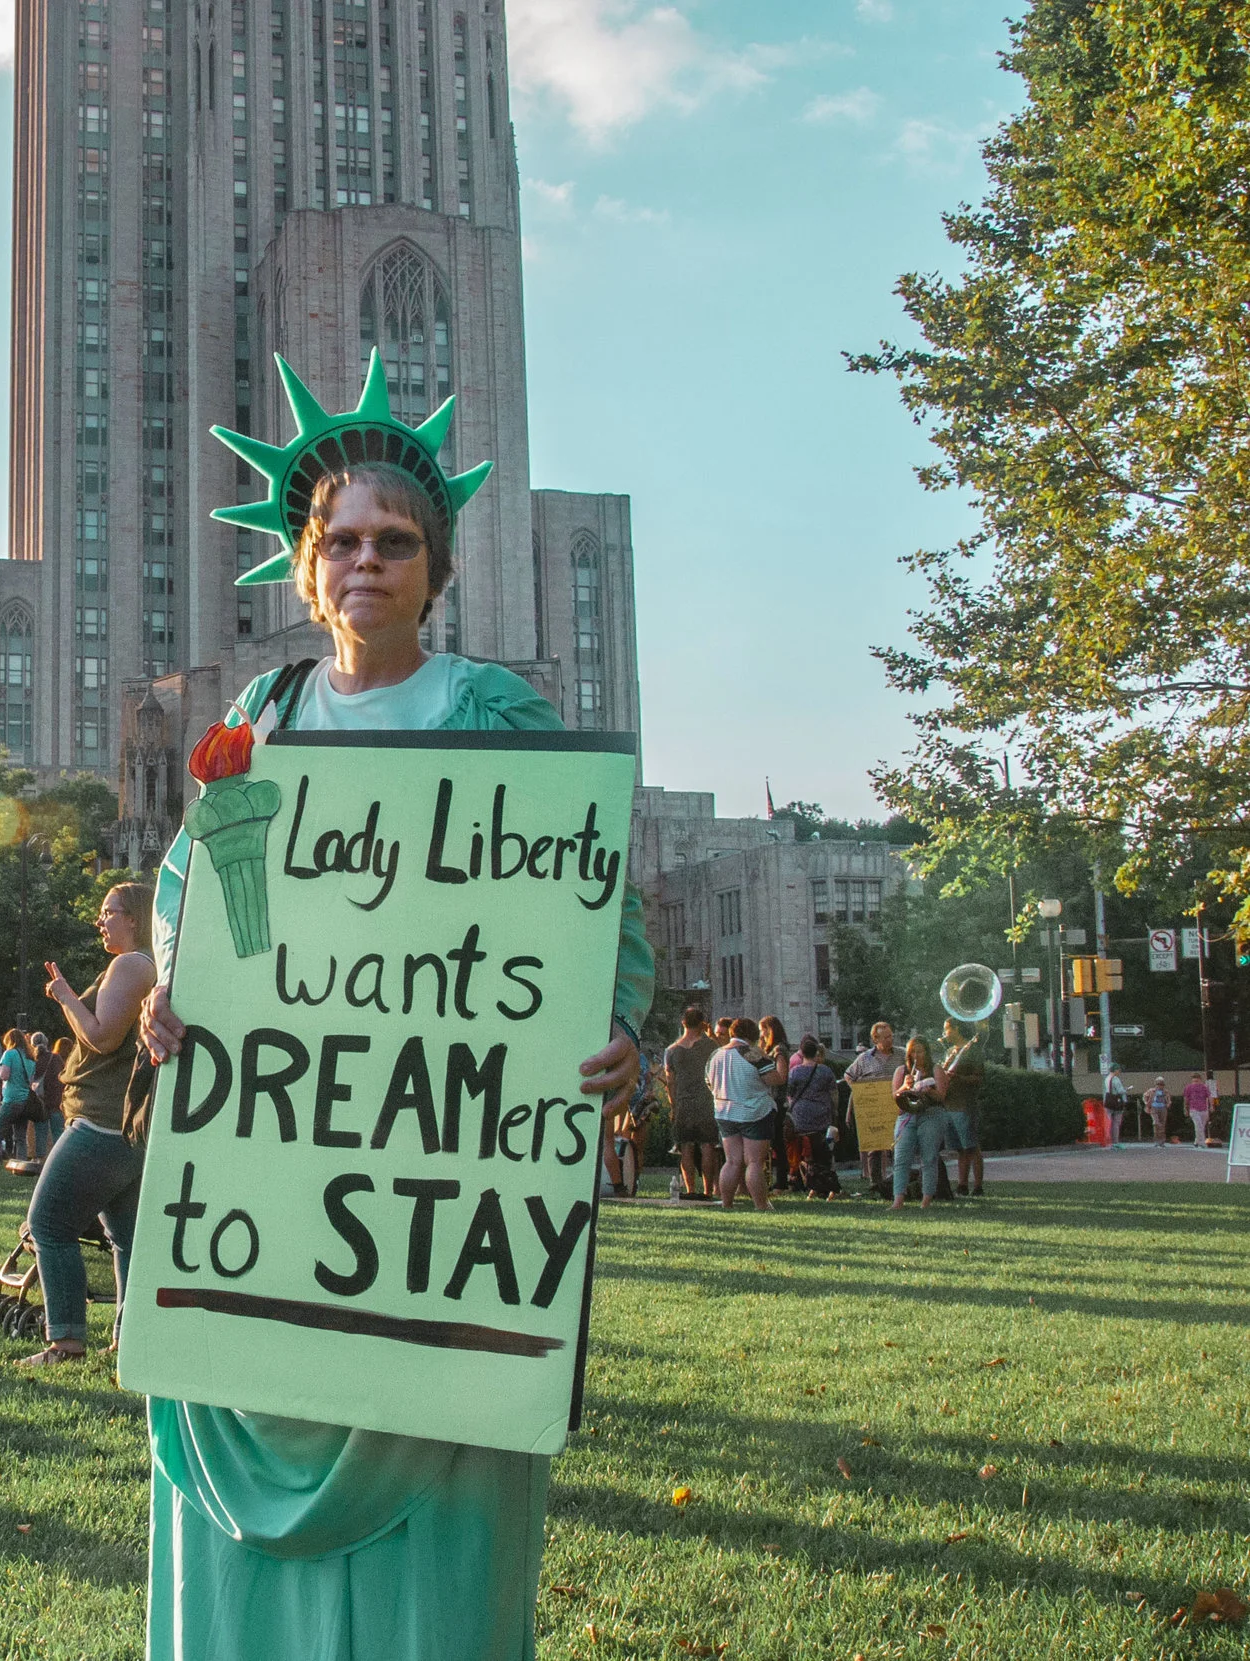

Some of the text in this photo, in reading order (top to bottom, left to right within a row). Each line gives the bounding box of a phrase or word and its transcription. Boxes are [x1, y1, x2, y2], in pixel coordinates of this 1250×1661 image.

[284, 775, 621, 911] Lady Liberty
[276, 924, 544, 1020] wants
[170, 1024, 595, 1166] DREAMers
[164, 1161, 592, 1308] to STAY
